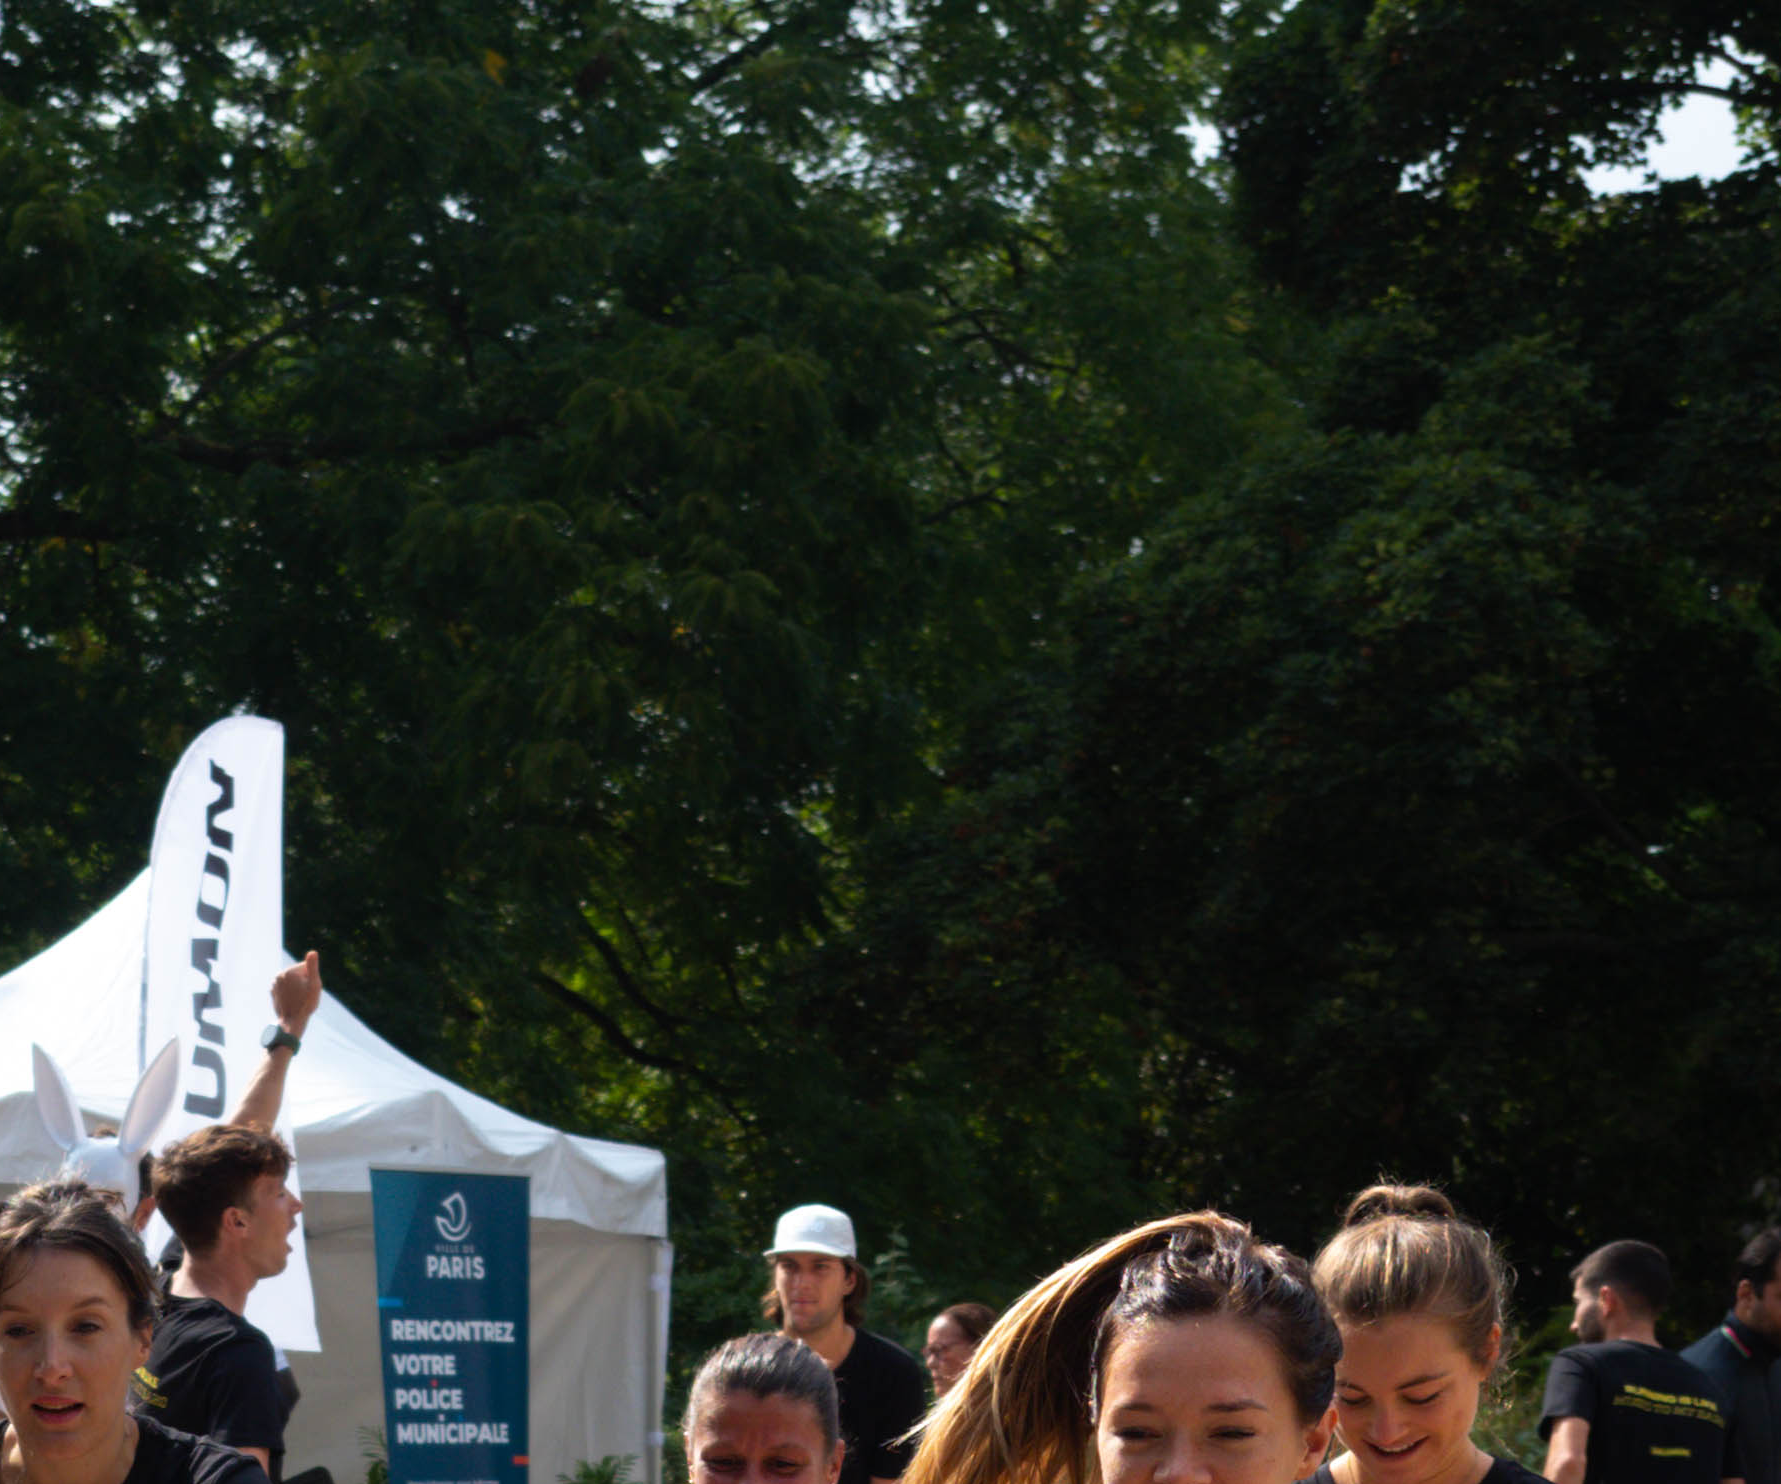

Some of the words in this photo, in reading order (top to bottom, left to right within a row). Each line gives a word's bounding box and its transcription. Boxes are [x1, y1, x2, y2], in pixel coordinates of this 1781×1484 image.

[426, 1255, 485, 1279] PARIS
[391, 1319, 515, 1342] RENCONTREZ
[392, 1353, 457, 1376] VOTRE
[394, 1388, 463, 1410] POLICE
[396, 1422, 511, 1444] MUNICIPALE
